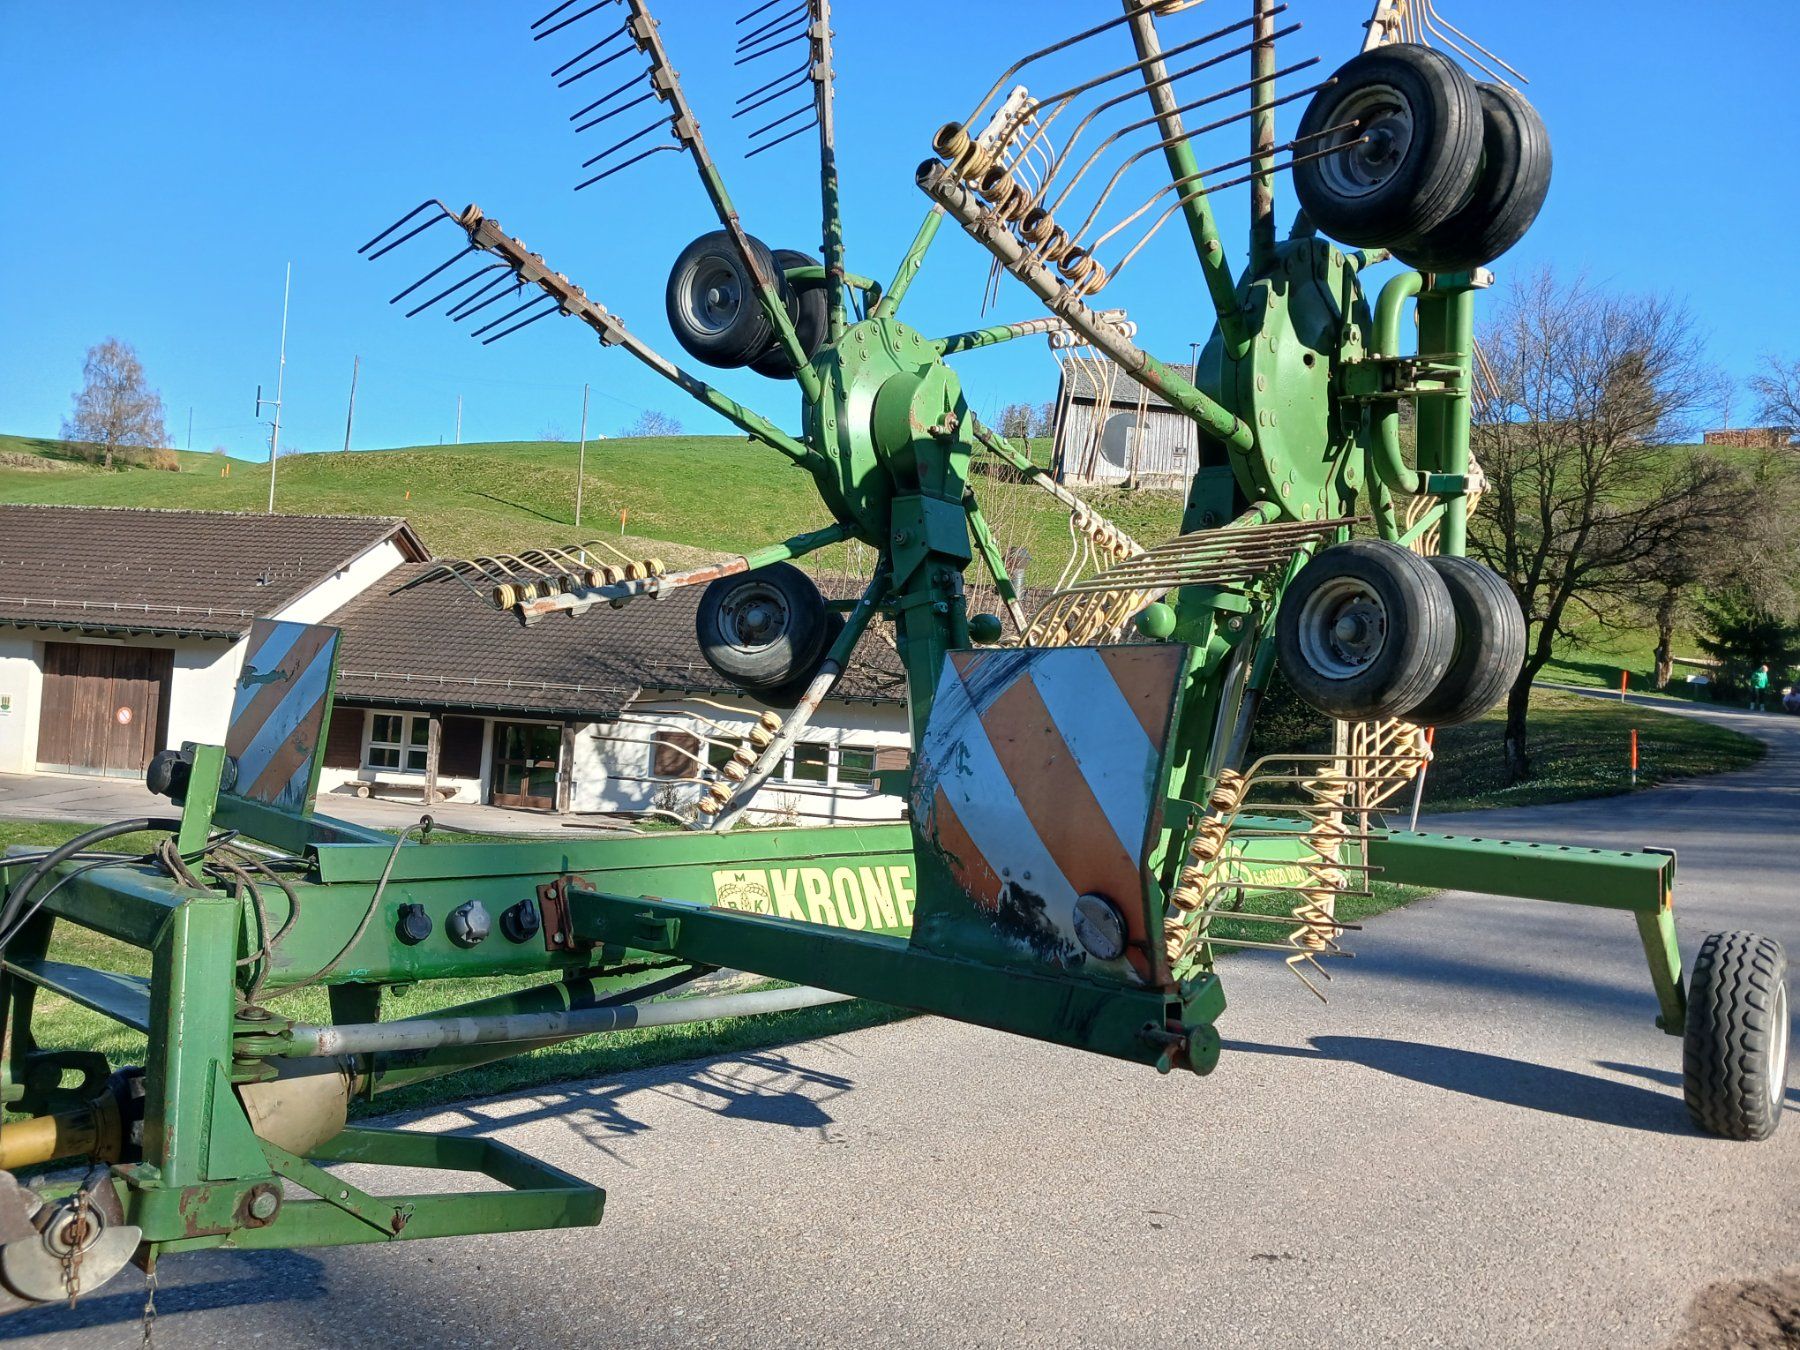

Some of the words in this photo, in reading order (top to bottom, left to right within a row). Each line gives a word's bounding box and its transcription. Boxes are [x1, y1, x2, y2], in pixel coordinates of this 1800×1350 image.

[734, 873, 746, 882] M
[1287, 865, 1305, 882] DUO
[770, 866, 915, 930] KRONE
[754, 899, 763, 913] K
